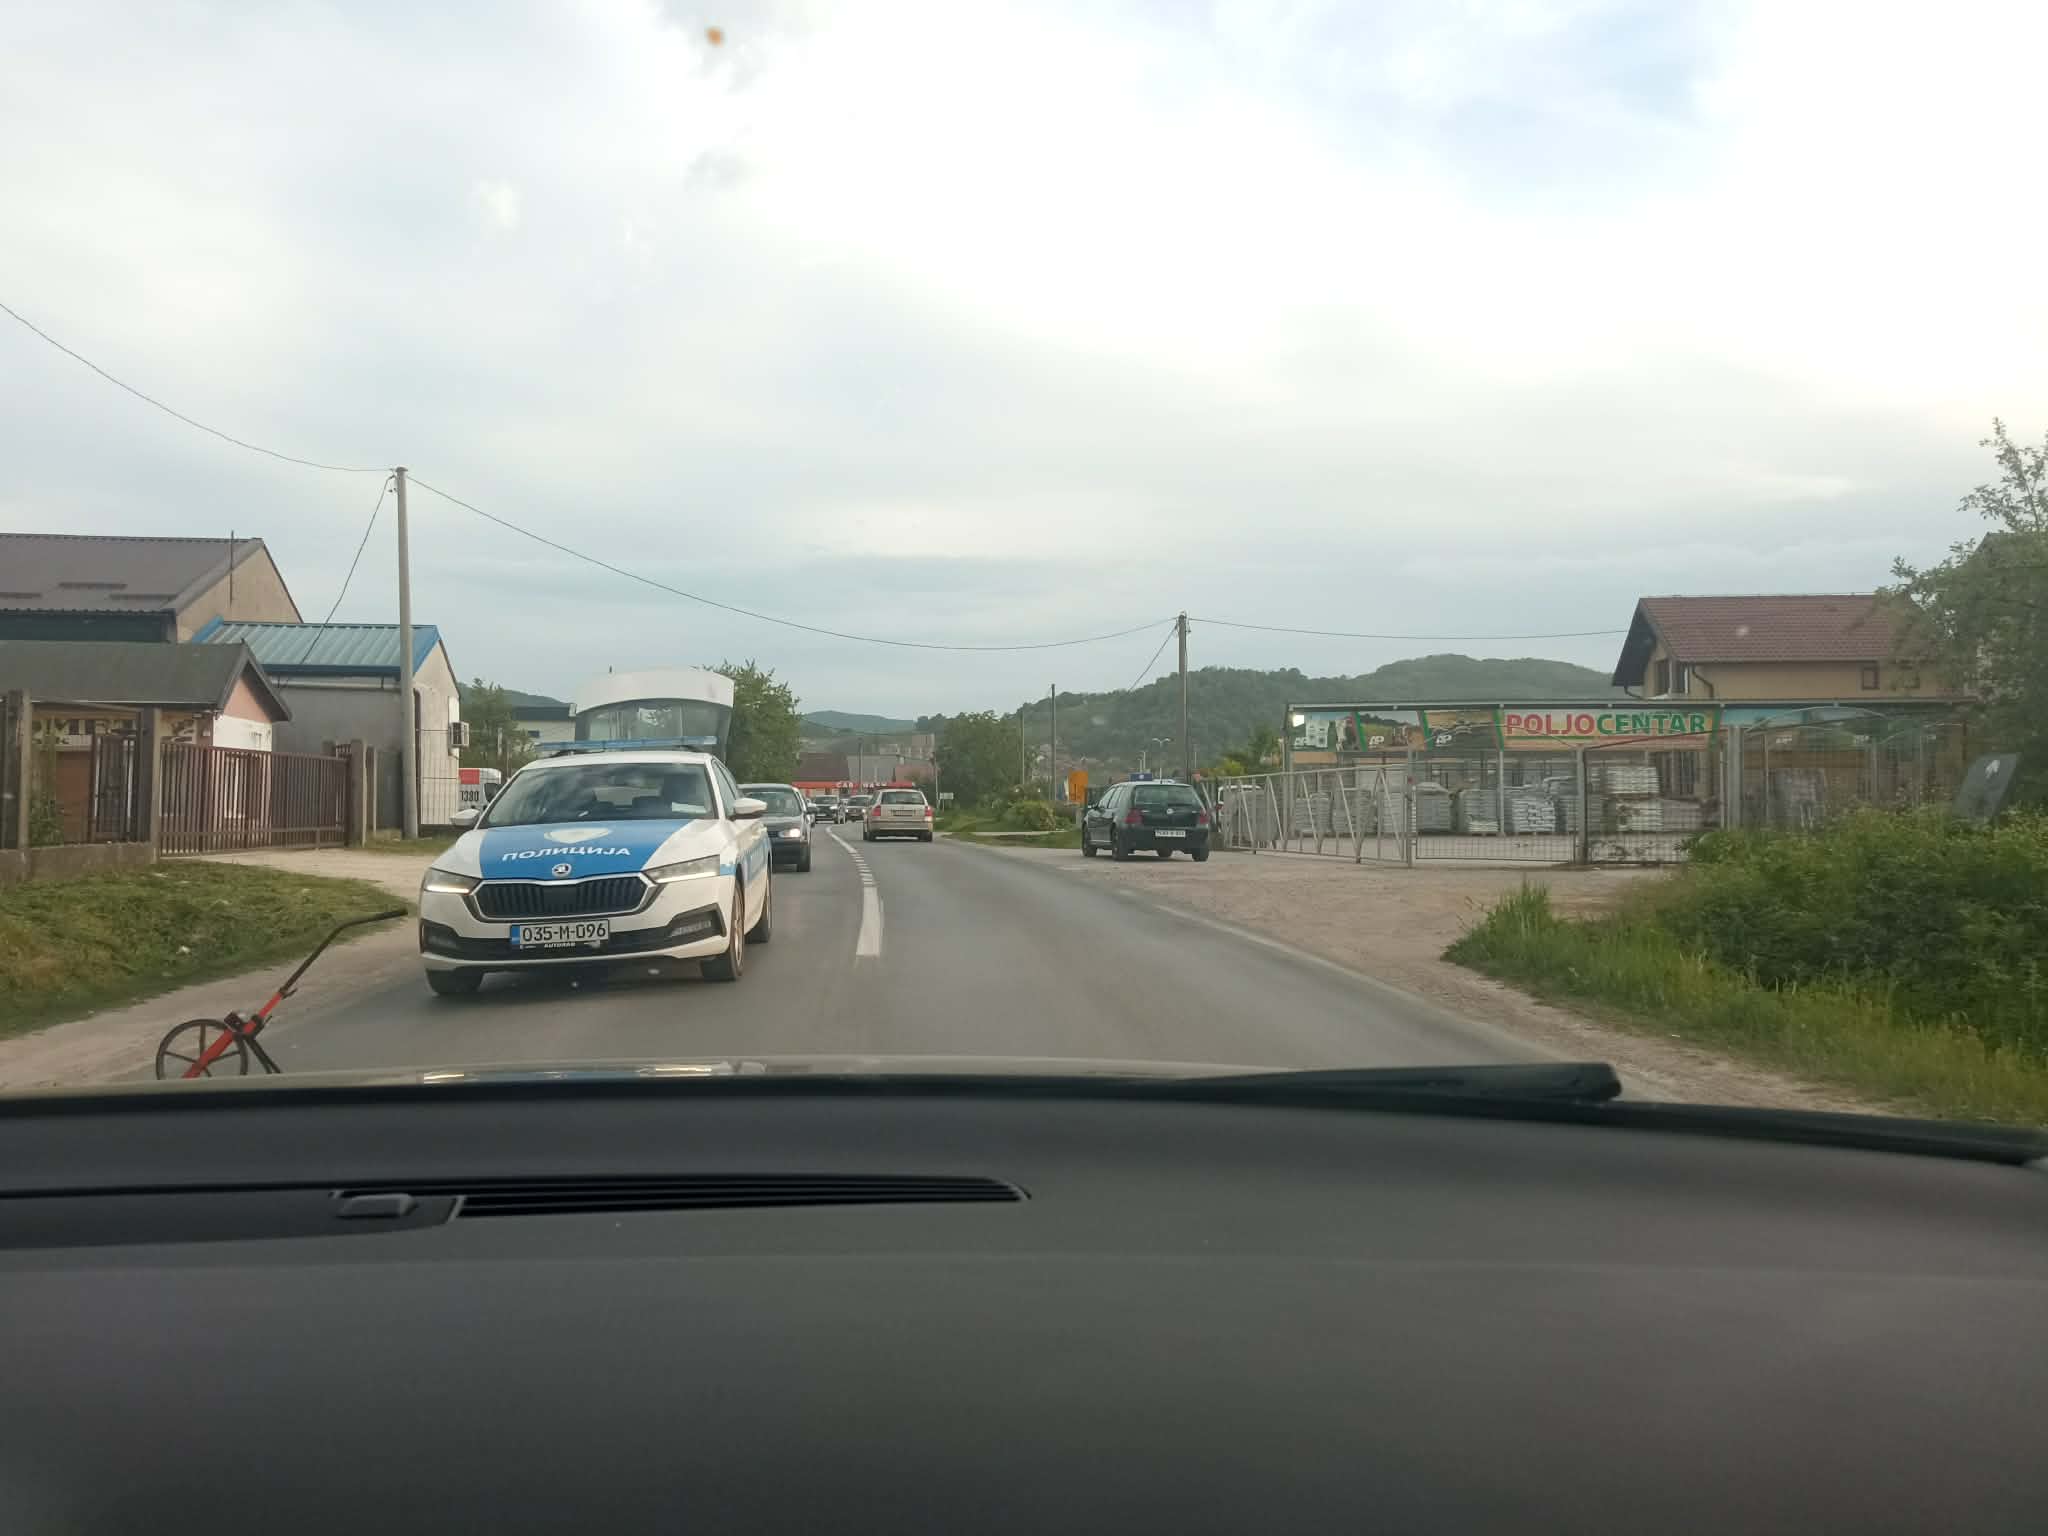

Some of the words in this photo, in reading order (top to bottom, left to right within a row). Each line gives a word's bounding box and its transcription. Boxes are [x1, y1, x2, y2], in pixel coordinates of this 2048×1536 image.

[1506, 713, 1705, 736] POLJOCENTAR
[502, 846, 631, 861] ПОЛИЦИЈА
[522, 923, 606, 942] 035-M-096
